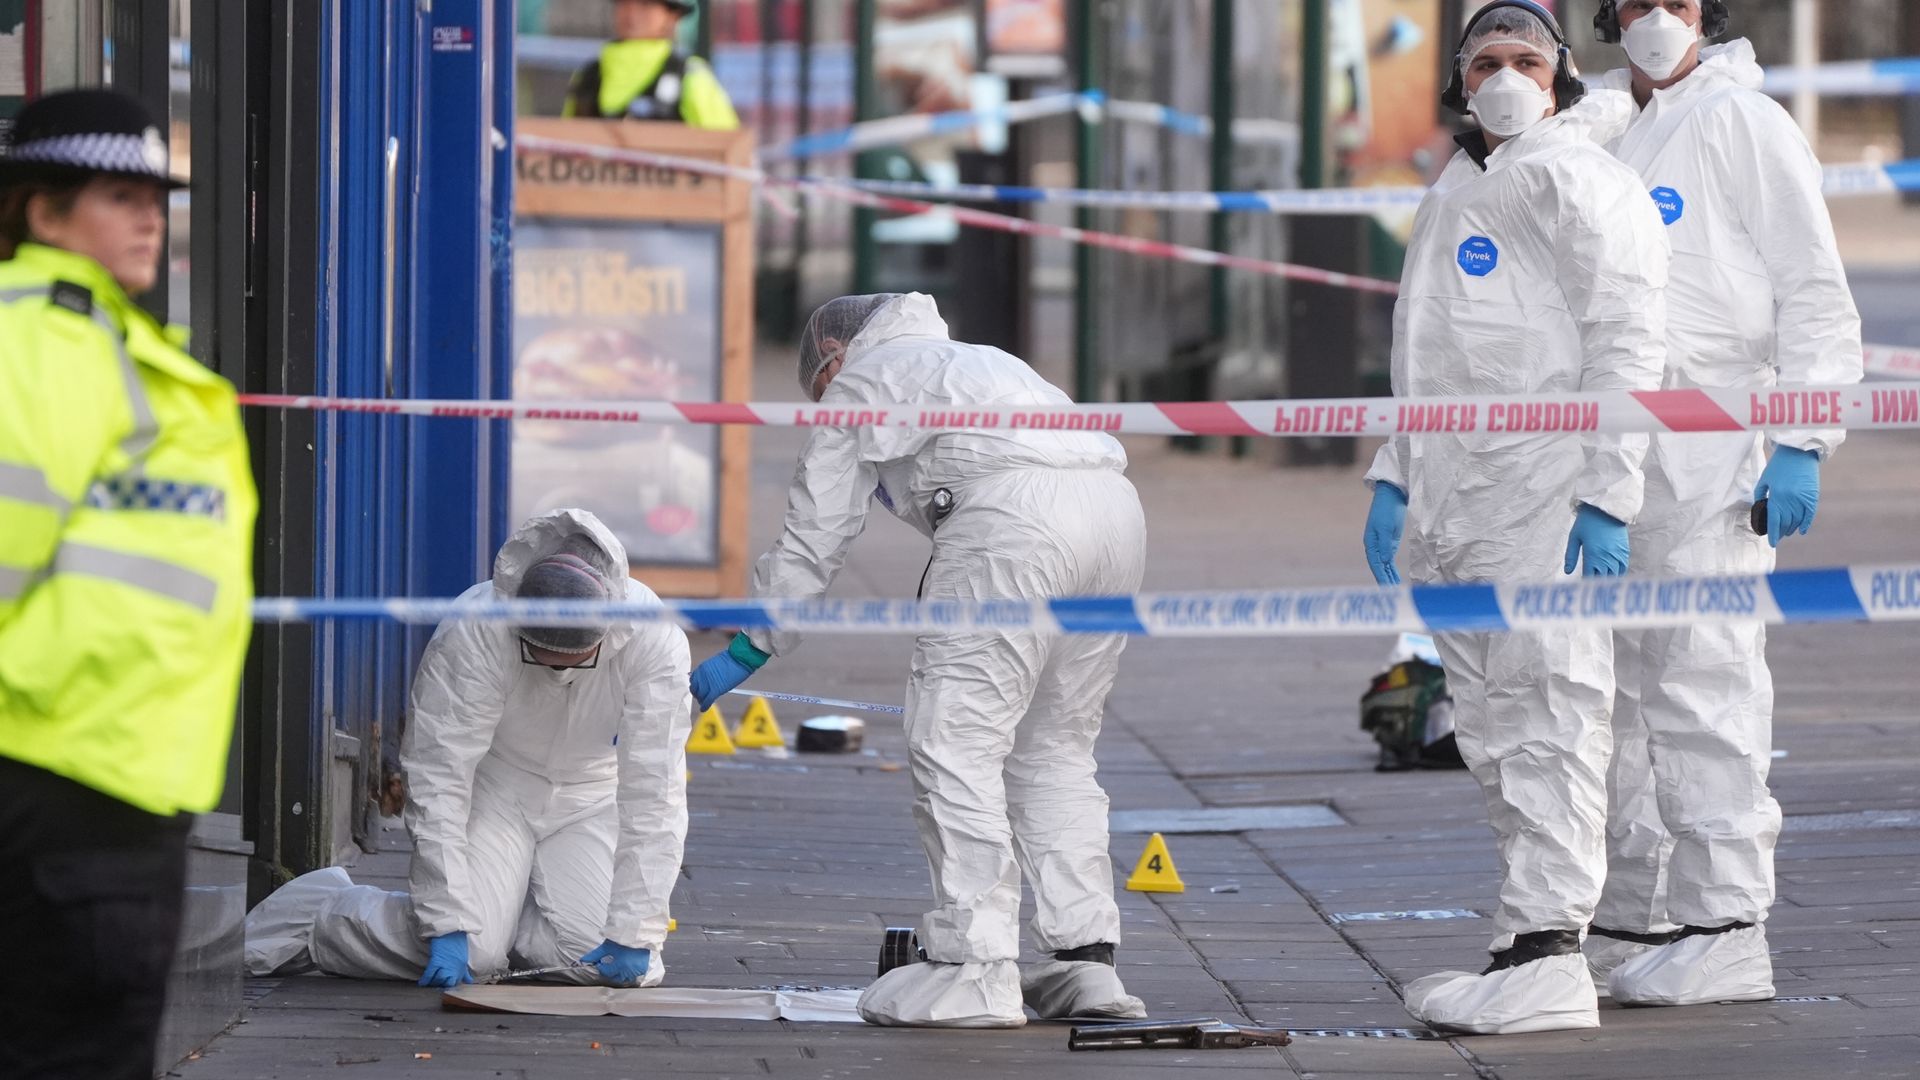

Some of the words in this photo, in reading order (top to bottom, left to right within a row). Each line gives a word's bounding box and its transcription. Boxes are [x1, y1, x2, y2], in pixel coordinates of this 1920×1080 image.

[1654, 200, 1676, 211] yvek
[1465, 249, 1490, 261] Tyvek
[1513, 584, 1577, 617] POLICE
[1581, 582, 1622, 616] LINE
[1656, 578, 1694, 614] NOT
[1695, 577, 1757, 613] CROSS
[704, 722, 717, 739] 3
[754, 716, 766, 733] 2
[1147, 853, 1163, 874] 4
